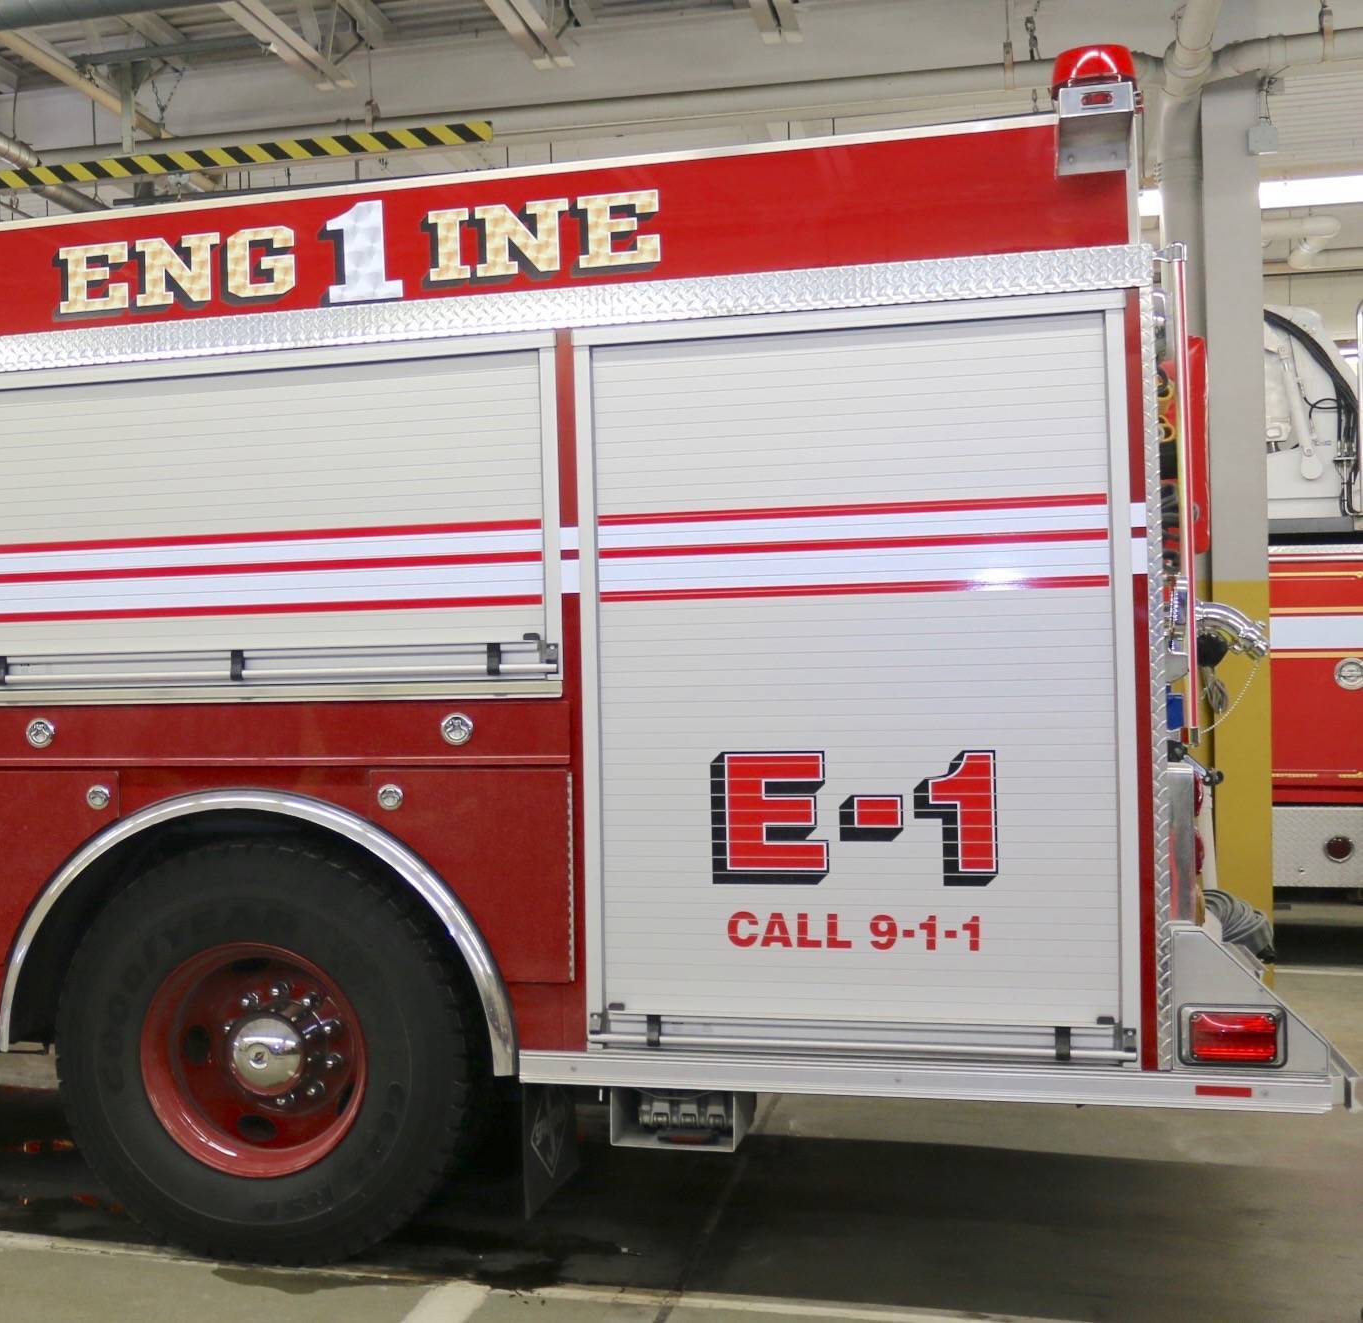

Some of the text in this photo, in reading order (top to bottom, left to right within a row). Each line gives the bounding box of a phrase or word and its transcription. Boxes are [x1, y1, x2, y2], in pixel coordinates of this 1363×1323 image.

[710, 750, 998, 887] E-1
[727, 911, 981, 952] CALL 9-1-1
